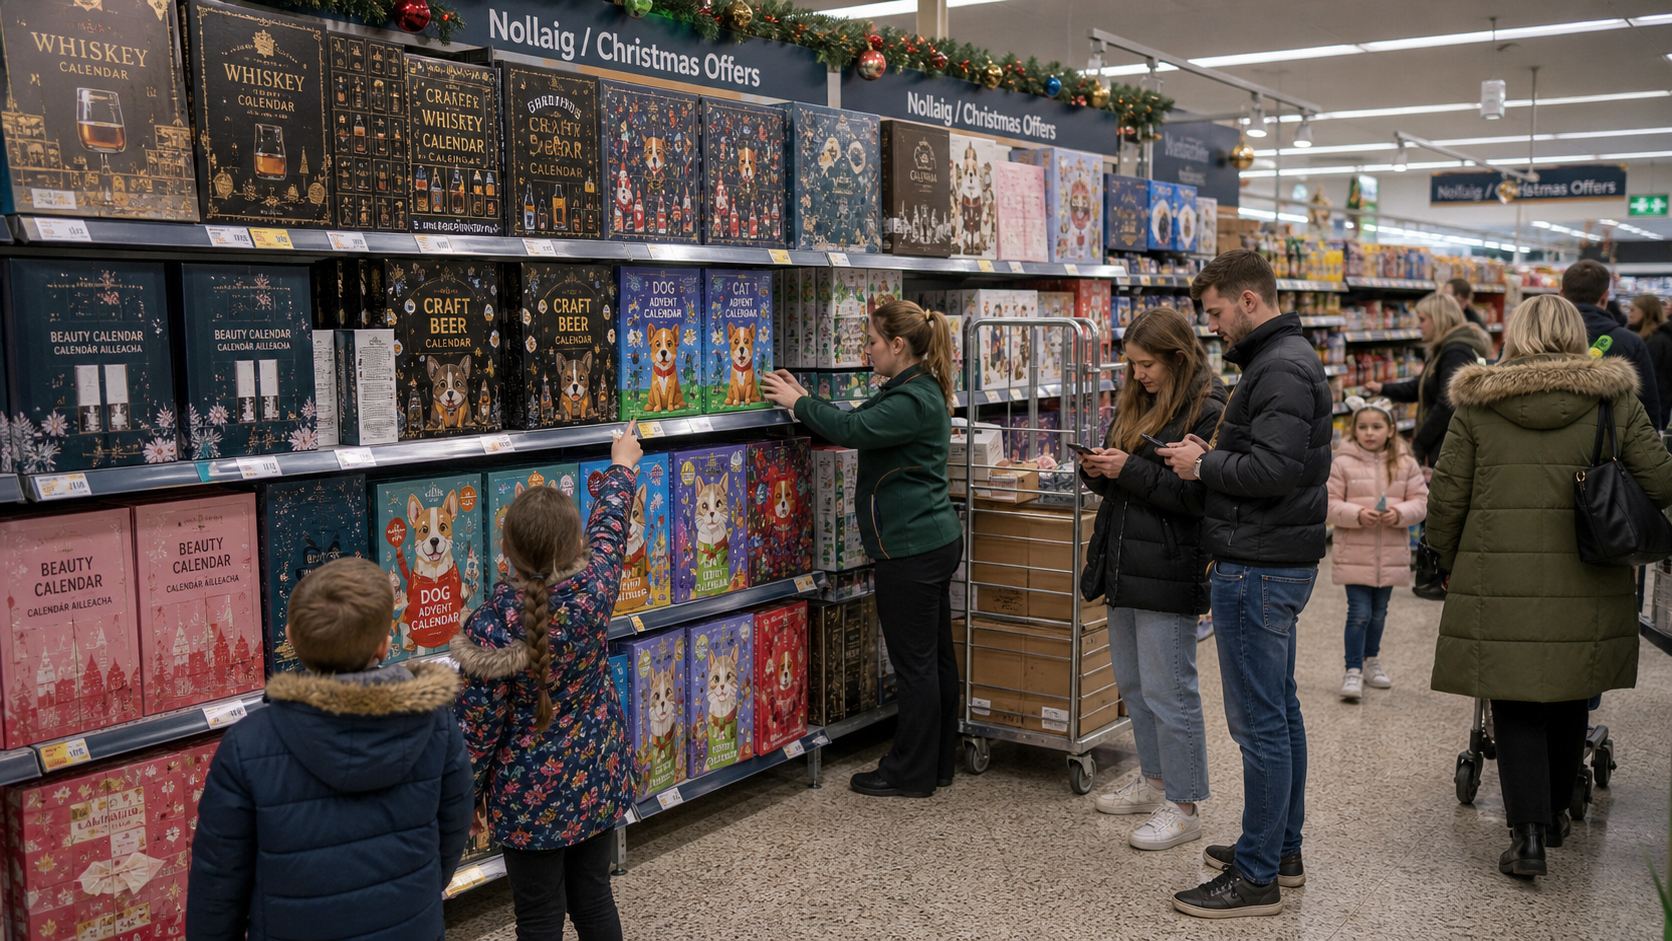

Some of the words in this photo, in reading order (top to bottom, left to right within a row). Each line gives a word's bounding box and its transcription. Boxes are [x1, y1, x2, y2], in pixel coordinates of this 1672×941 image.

[31, 31, 148, 67] WHISKEY
[489, 9, 575, 61] Nollaig
[581, 27, 591, 57] /
[597, 32, 699, 77] Christmas
[704, 53, 760, 87] Offers
[59, 62, 129, 80] CALENDAR
[223, 63, 305, 92] WHISKEY
[907, 91, 952, 126] Nollaig
[955, 100, 961, 123] /
[963, 102, 1021, 134] Christmas
[1023, 114, 1056, 139] Offers
[423, 133, 485, 153] CALENDAR
[530, 162, 583, 178] CALENDAR
[1570, 179, 1617, 196] Offers
[652, 281, 675, 294] DOG
[732, 281, 750, 295] CAT
[423, 298, 470, 314] CRAFT
[553, 298, 591, 314] CRAFT
[430, 318, 467, 334] BEER
[558, 316, 589, 332] BEER
[50, 331, 90, 343] BEAUTY
[93, 331, 144, 342] CALENDAR
[214, 329, 247, 340] BEAUTY
[249, 329, 291, 339] CALENDAR
[425, 338, 471, 348] CALENDAR
[179, 537, 223, 556] BEAUTY
[41, 556, 93, 577] BEAUTY
[172, 554, 231, 574] CALENDAR
[34, 574, 103, 597] CALENDAR
[420, 585, 450, 604] DOG
[411, 612, 459, 630] CALENDAR
